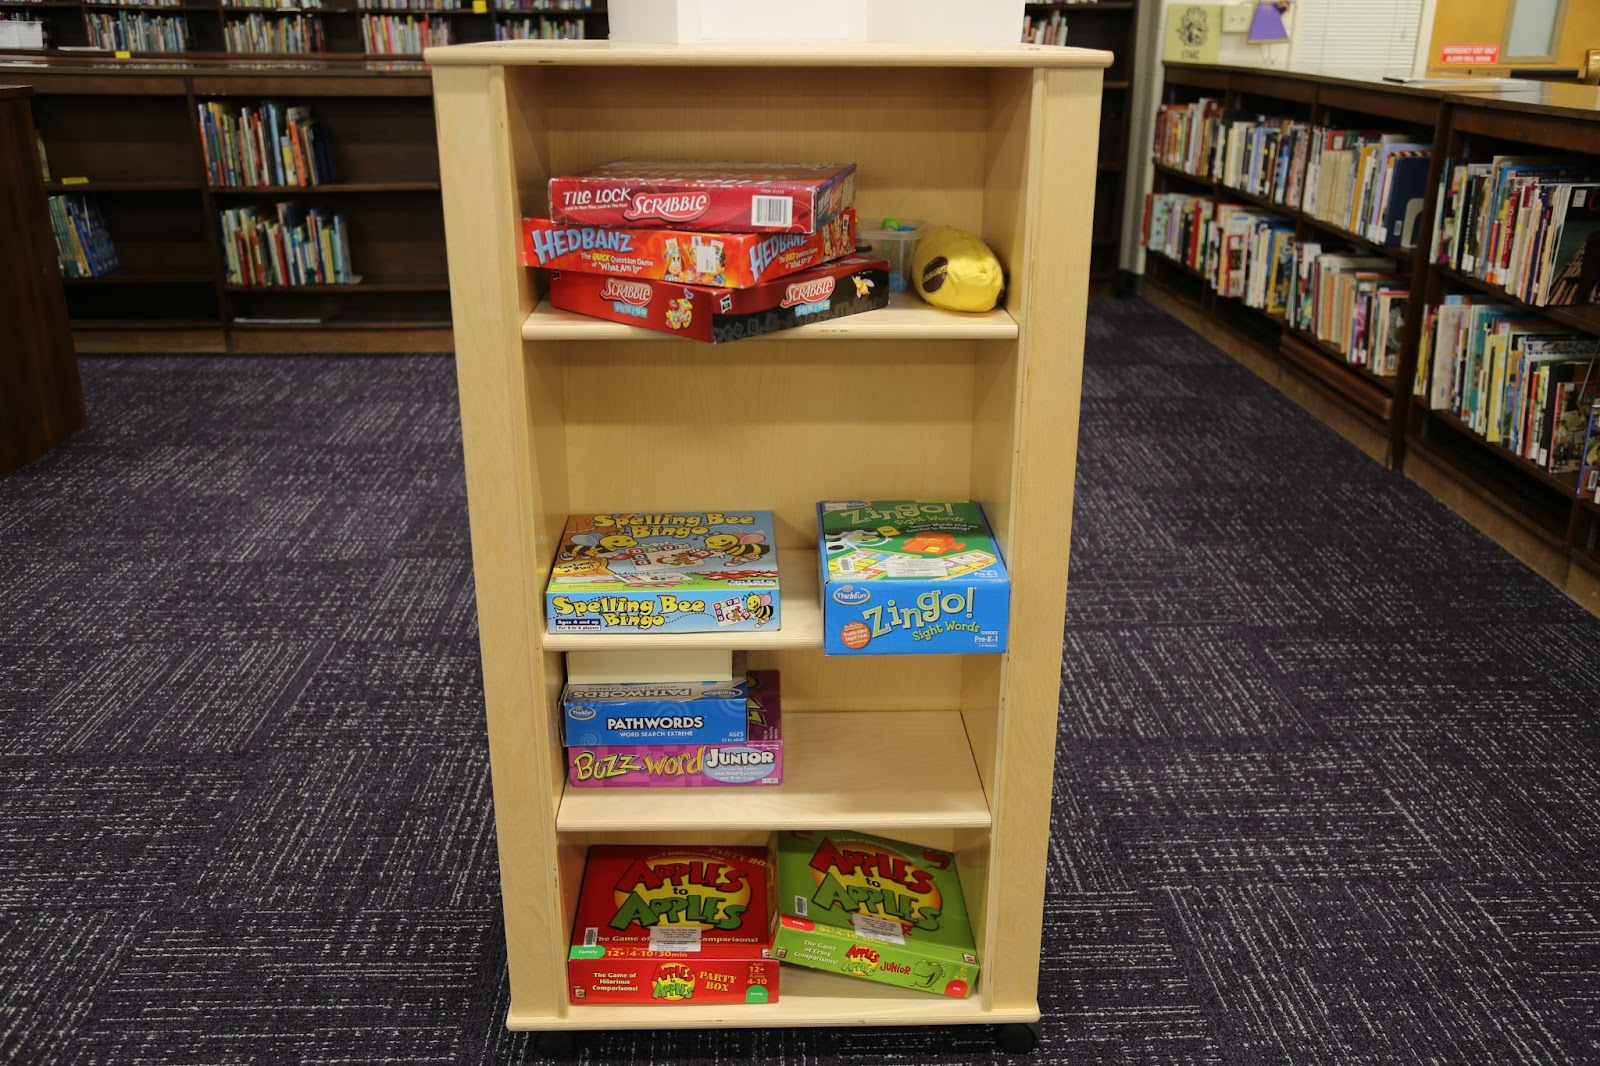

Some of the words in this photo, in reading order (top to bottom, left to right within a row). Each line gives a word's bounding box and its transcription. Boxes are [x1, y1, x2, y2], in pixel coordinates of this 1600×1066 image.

[595, 188, 632, 204] LOCK
[532, 228, 634, 266] HEDBANZ
[592, 253, 610, 262] QUICK
[611, 256, 636, 264] Question
[637, 258, 654, 266] Game
[615, 303, 647, 316] JUNIOR
[796, 302, 830, 316] JUNIOR
[592, 513, 701, 529] Spelling
[704, 512, 755, 525] Bee
[840, 503, 953, 524] Zingo!
[894, 515, 925, 525] Sight
[630, 526, 709, 539] Bingo
[553, 596, 655, 617] Spelling
[657, 595, 705, 614] Bee
[862, 587, 974, 638] Zingo!
[602, 612, 665, 629] Bingo
[912, 624, 944, 641] Sight
[945, 620, 980, 632] Words
[573, 689, 691, 698] PATHWORDS
[607, 716, 704, 730] PATHWORDS
[706, 749, 774, 768] JUNIOR
[809, 837, 934, 894] APPLES
[614, 858, 748, 893] APPLES
[866, 877, 881, 888] to
[672, 886, 688, 896] to
[812, 872, 942, 931] APPLES
[609, 890, 747, 930] APPLES
[794, 952, 839, 964] Comparisons!
[814, 949, 831, 957] Crazy
[846, 944, 880, 963] APPLES
[880, 962, 911, 975] JUNIOR
[700, 971, 737, 984] PARTY
[653, 981, 694, 999] APPLES
[706, 982, 729, 992] BOX
